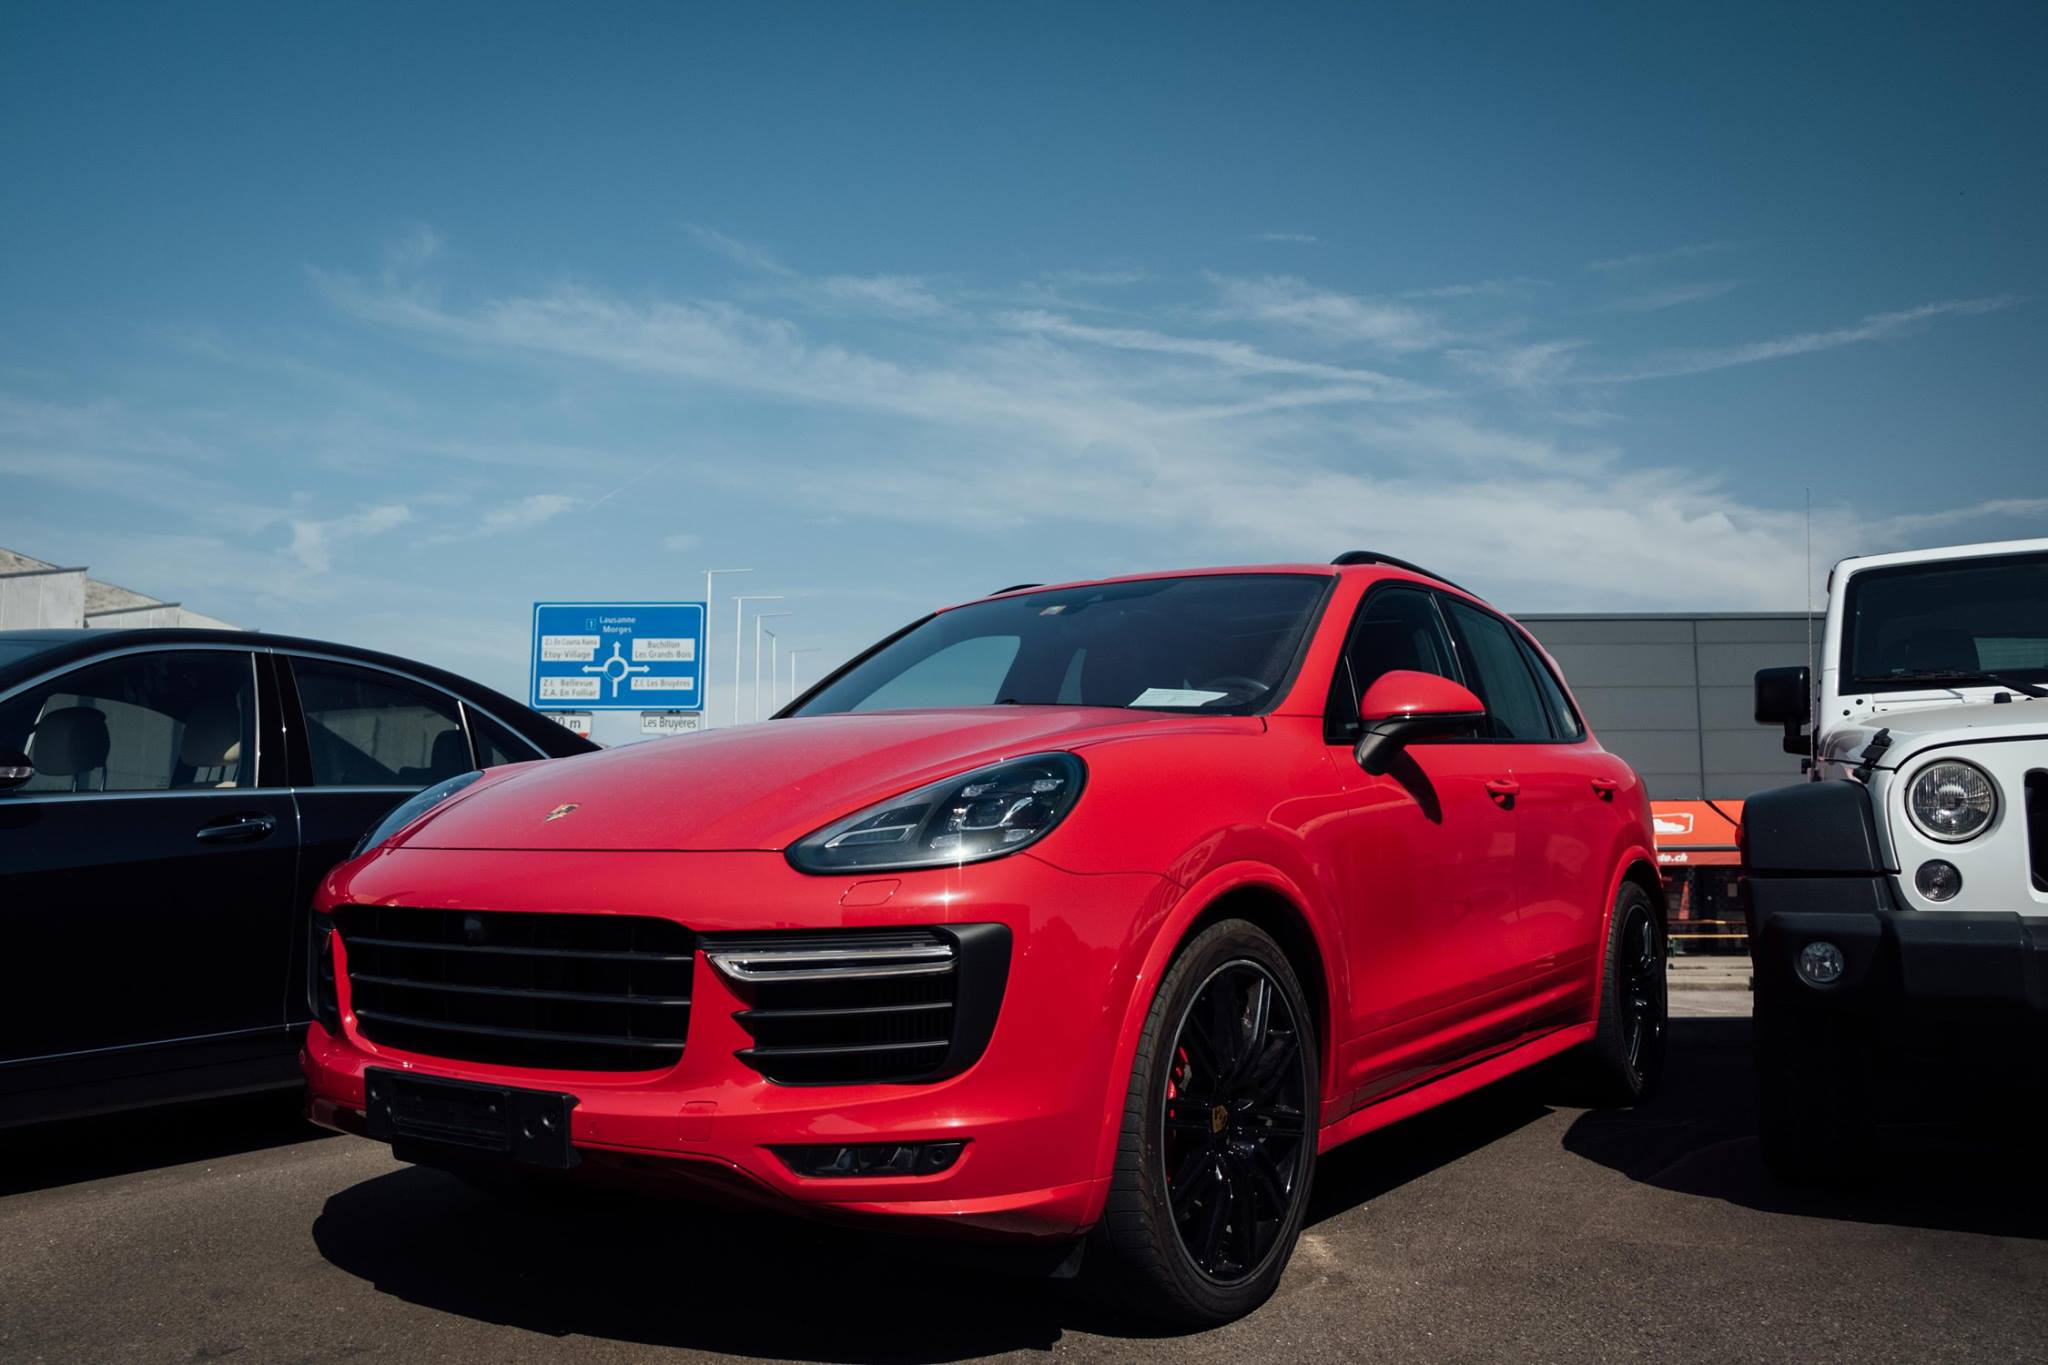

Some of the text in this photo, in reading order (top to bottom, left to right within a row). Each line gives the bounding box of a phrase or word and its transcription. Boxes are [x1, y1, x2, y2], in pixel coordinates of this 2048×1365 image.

[599, 616, 637, 624] Lausanne
[602, 625, 632, 635] Morges
[635, 650, 647, 659] Les
[560, 678, 594, 687] Bellevue
[646, 679, 658, 687] Les
[569, 719, 581, 729] m
[643, 716, 657, 728] Les
